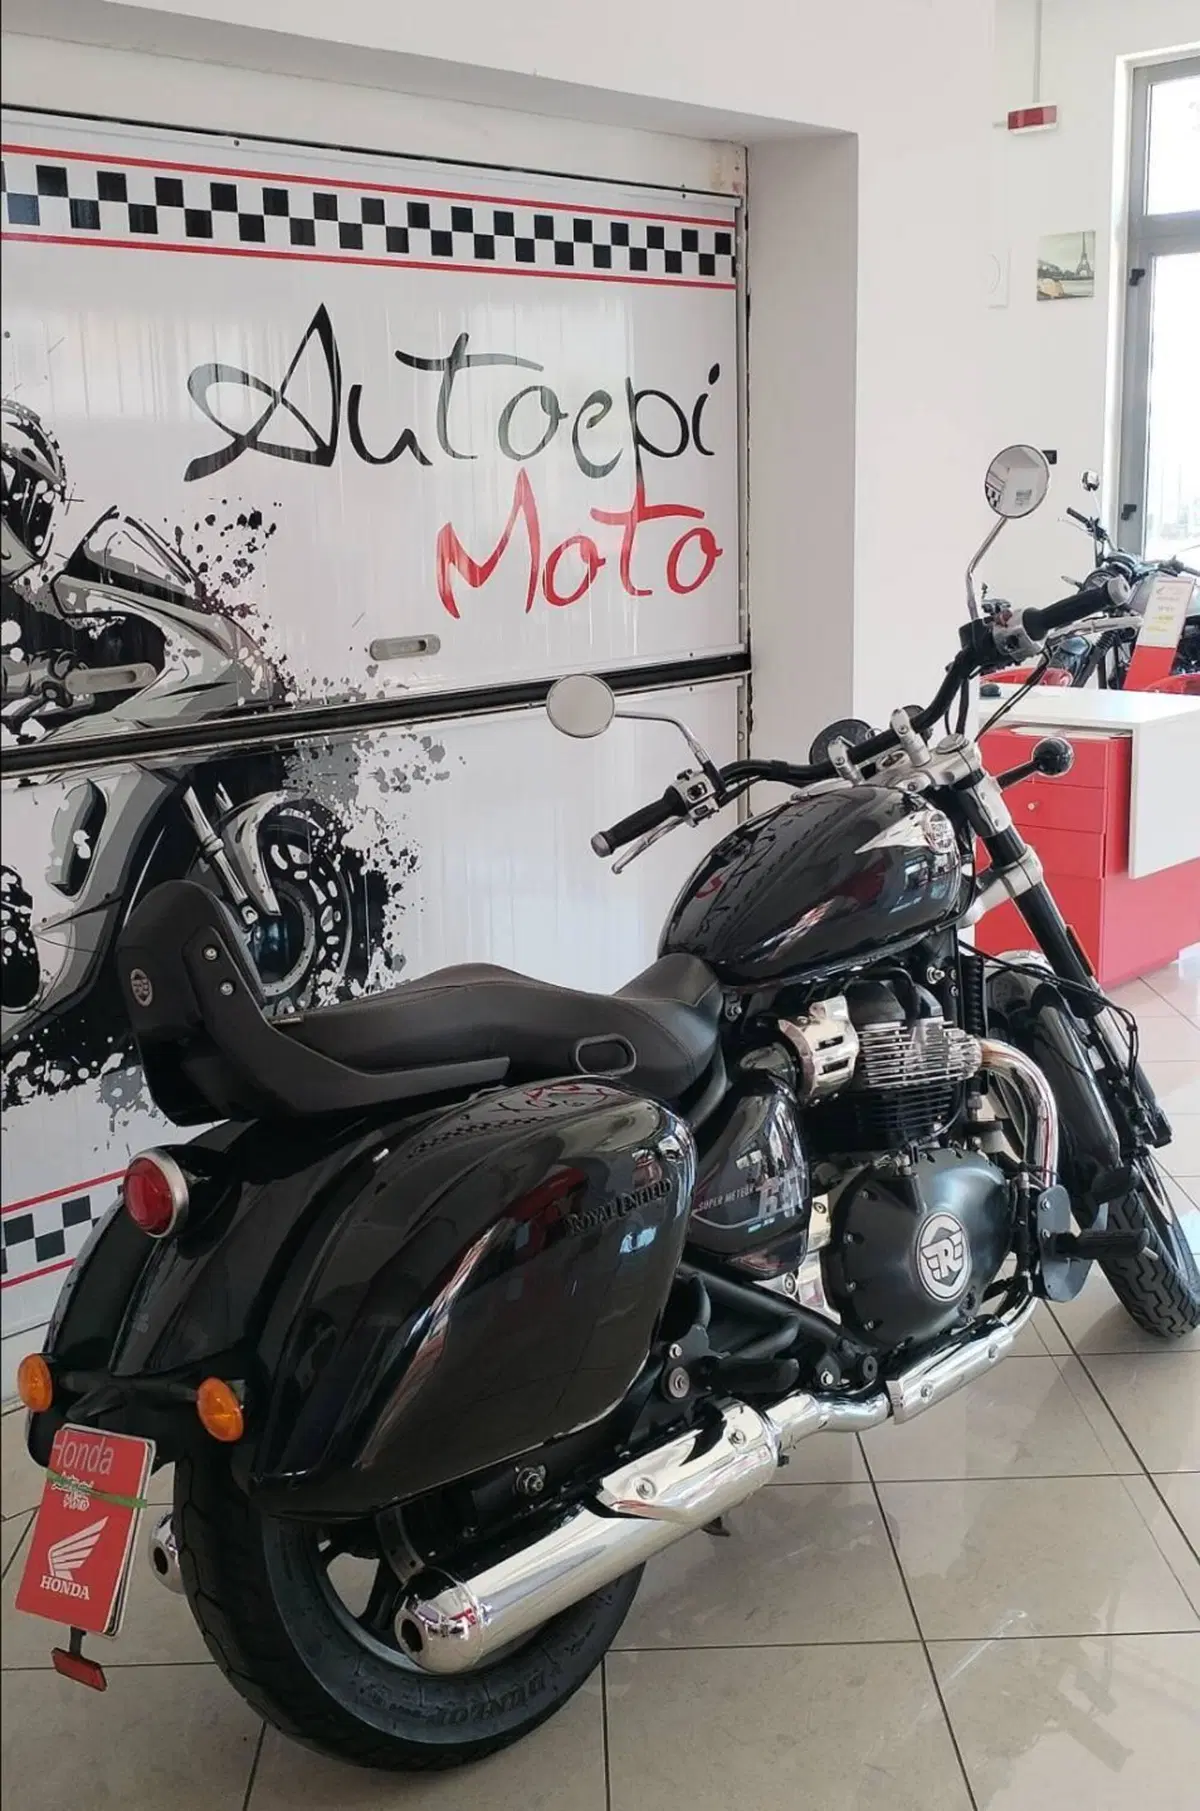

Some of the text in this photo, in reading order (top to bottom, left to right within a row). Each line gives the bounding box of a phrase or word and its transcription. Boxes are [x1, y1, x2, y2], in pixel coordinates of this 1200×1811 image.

[184, 303, 721, 484] Autoepi
[435, 467, 723, 619] Moto
[698, 1195, 723, 1210] SUPER
[40, 1575, 90, 1600] HONDA
